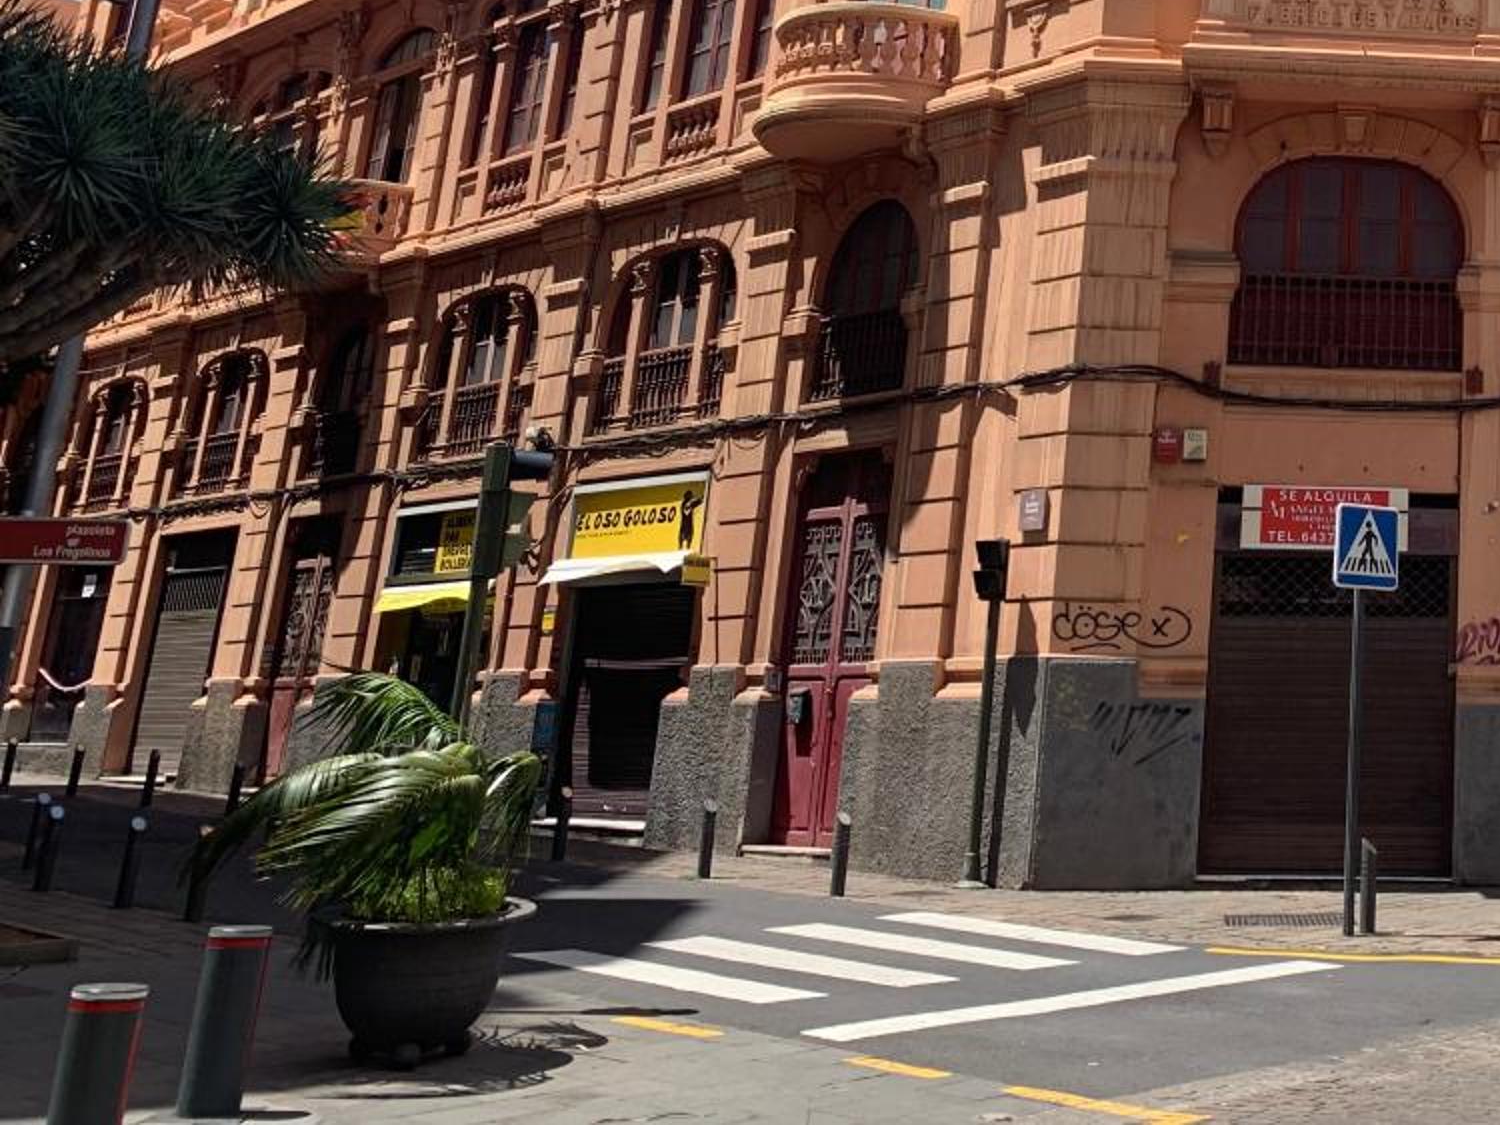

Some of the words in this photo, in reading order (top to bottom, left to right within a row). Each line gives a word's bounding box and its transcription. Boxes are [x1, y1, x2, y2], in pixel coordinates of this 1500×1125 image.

[1279, 490, 1298, 502] SE
[1303, 490, 1373, 503] ALQUILA
[577, 513, 591, 531] EL
[594, 512, 621, 528] OSO
[623, 506, 677, 527] GOLOSO
[66, 524, 115, 536] plazoleta
